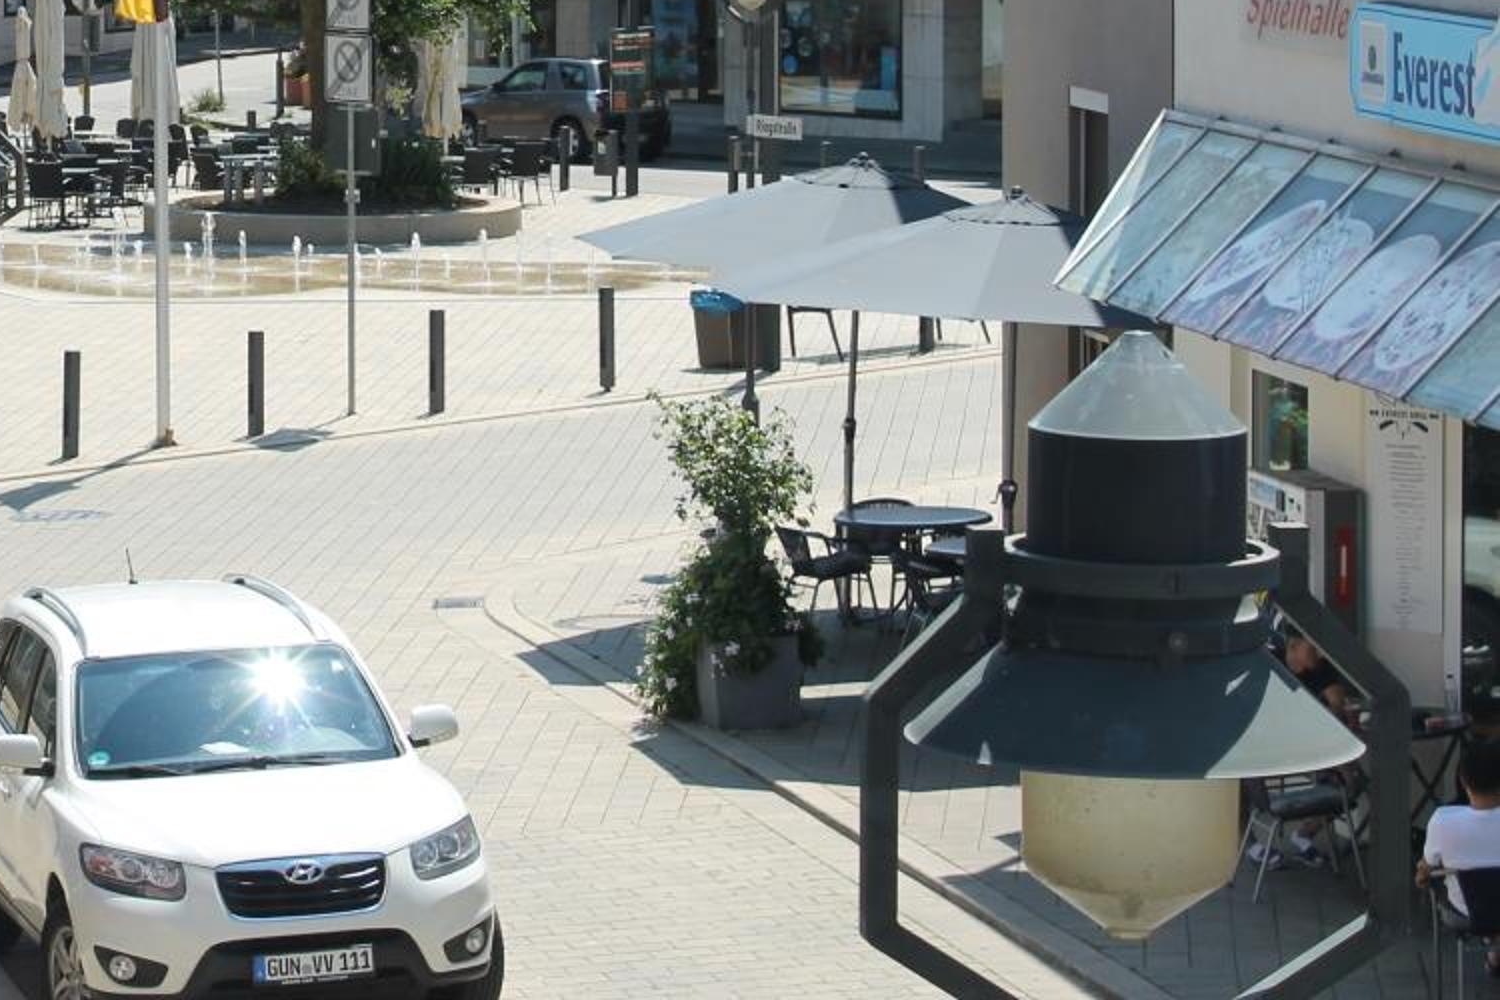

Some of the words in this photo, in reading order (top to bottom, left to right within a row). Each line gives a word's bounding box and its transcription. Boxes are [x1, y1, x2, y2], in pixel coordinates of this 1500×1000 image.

[1393, 31, 1476, 119] Everest
[267, 956, 301, 977] GUN
[312, 953, 334, 974] VV
[339, 949, 371, 971] 111
